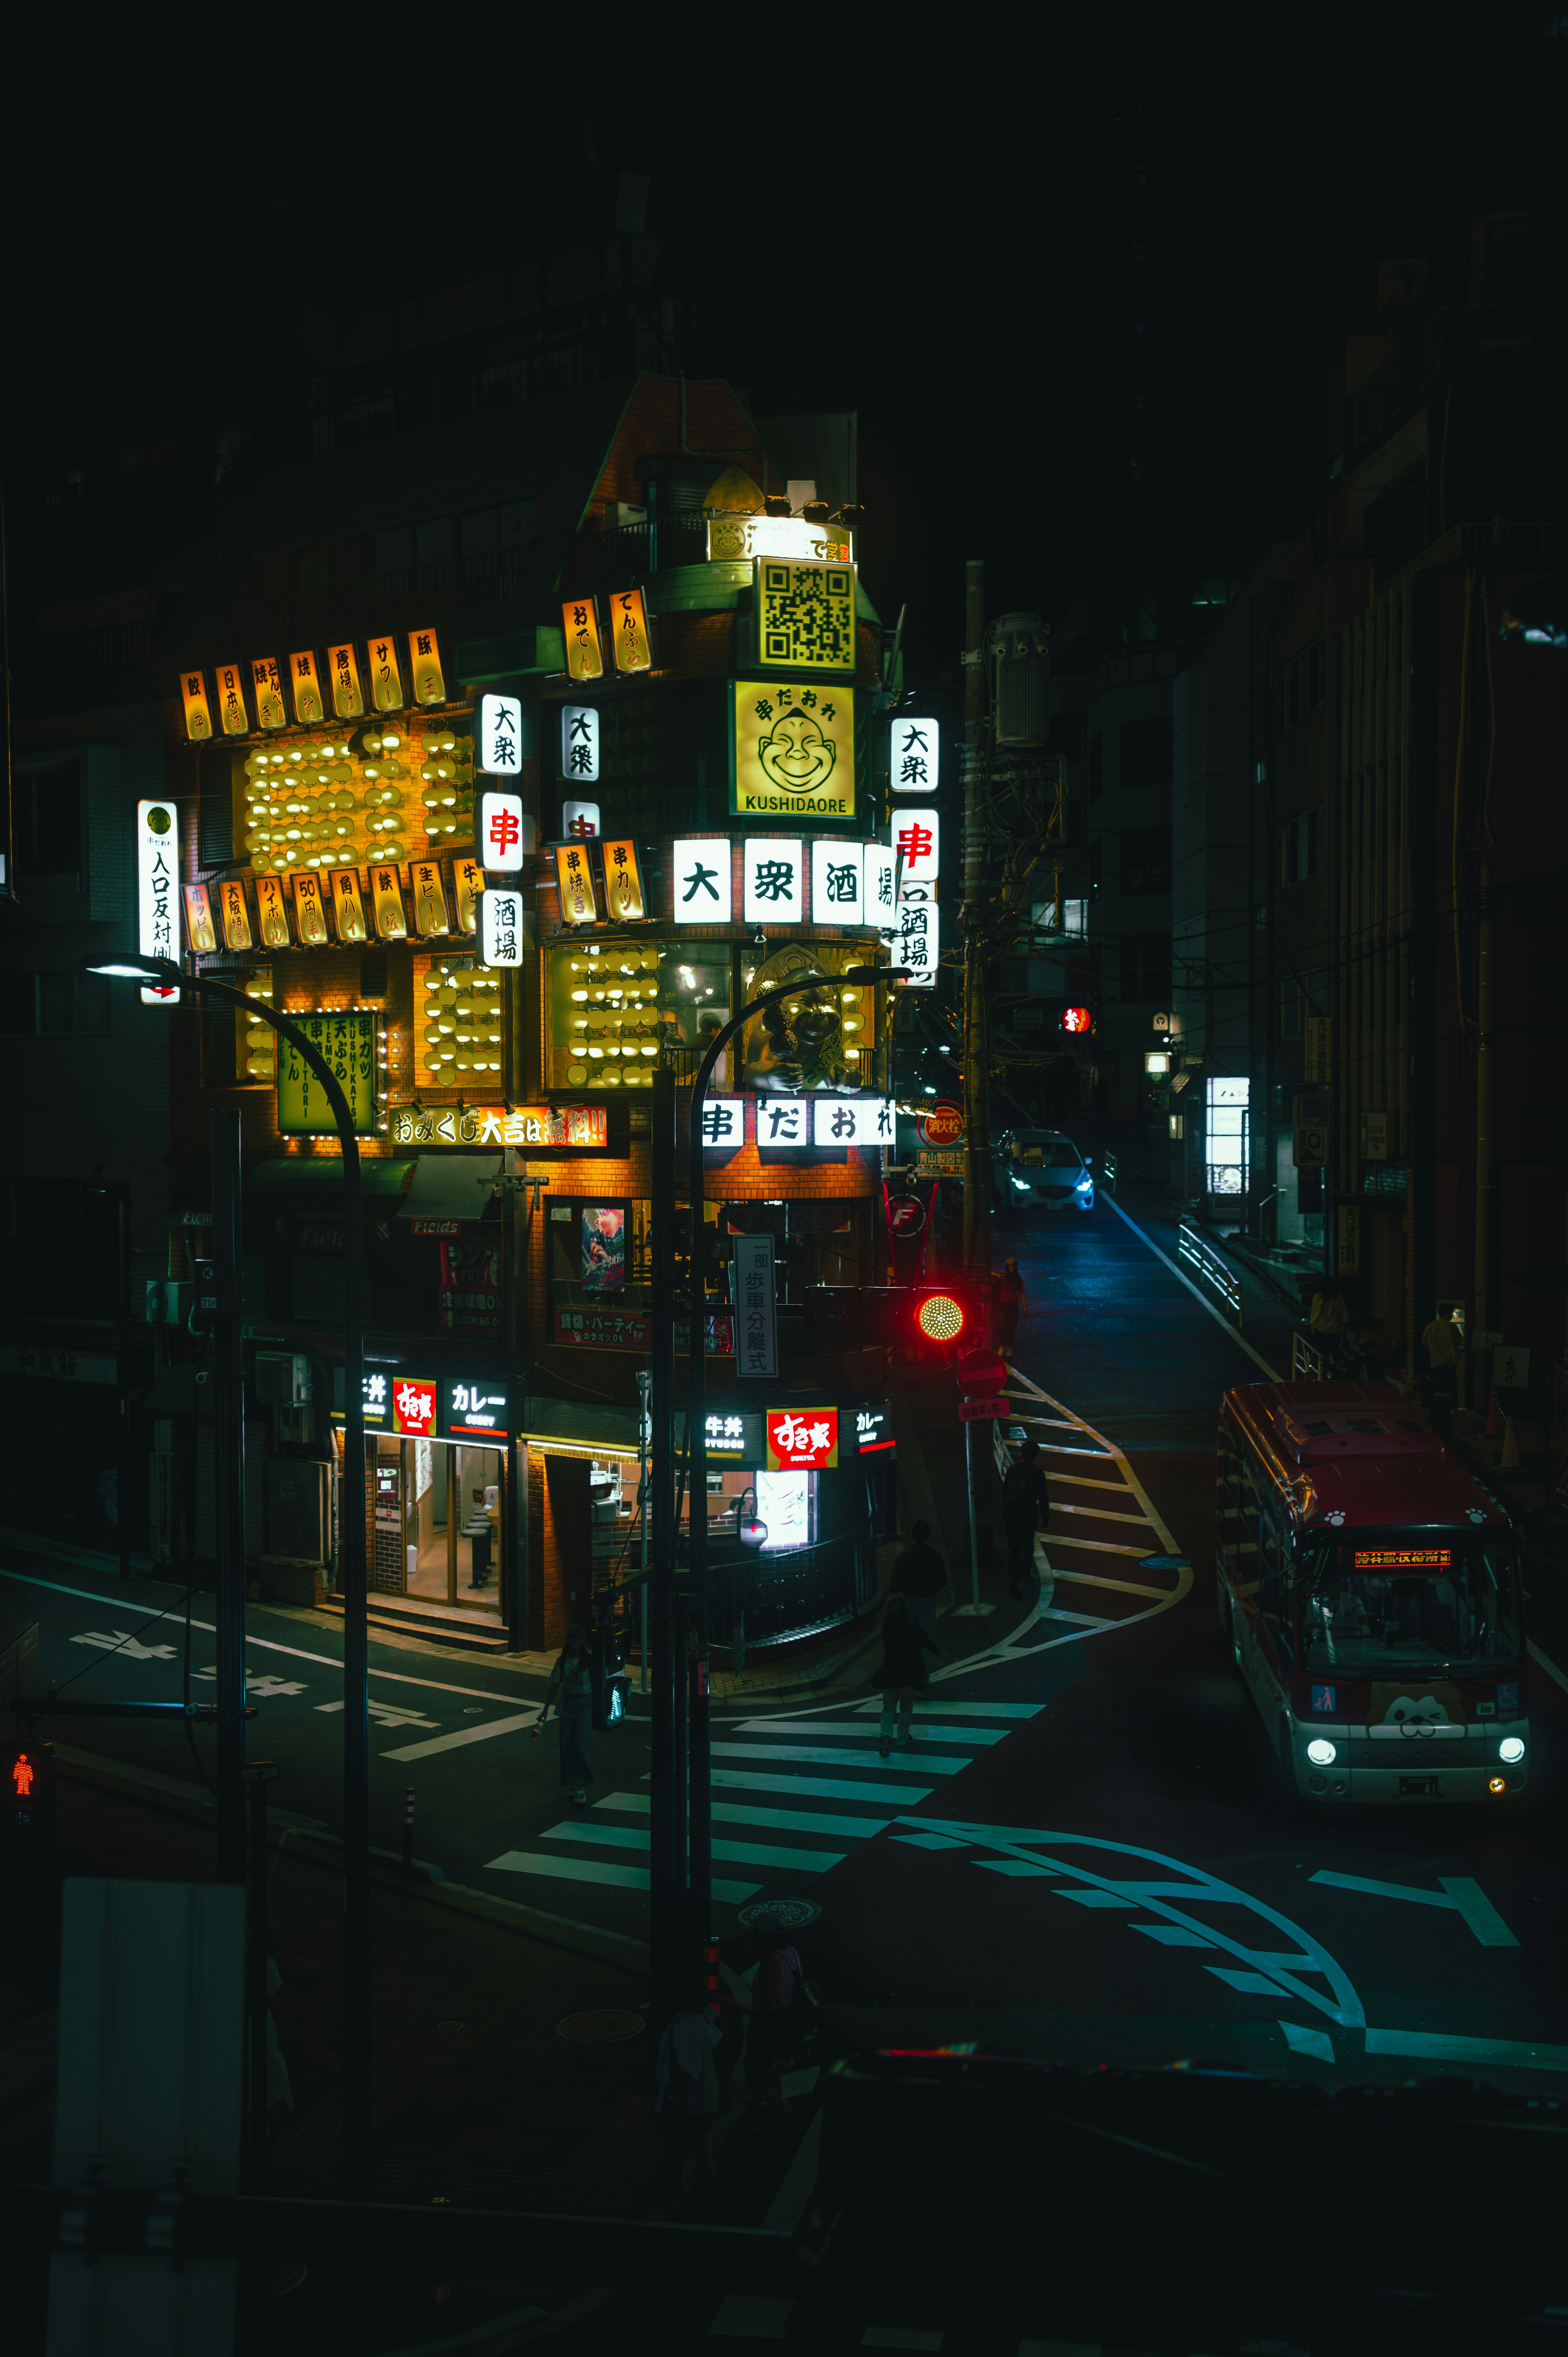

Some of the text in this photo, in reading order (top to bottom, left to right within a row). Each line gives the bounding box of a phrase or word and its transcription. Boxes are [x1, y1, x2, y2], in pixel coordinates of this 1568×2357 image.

[574, 606, 592, 671] おでん
[619, 593, 641, 666] てんぷら
[297, 656, 315, 716] 焼酎
[336, 649, 354, 710] 唐揚げ
[376, 643, 391, 703] サワー
[417, 634, 438, 697] 豚玉
[188, 676, 205, 733] 餃子
[224, 670, 242, 730] 日本酒
[754, 688, 836, 722] 串だおれ
[493, 702, 516, 767] 大衆
[900, 725, 929, 783] 大衆
[490, 807, 519, 856] 串
[745, 795, 847, 813] KUSHIDAORE
[896, 822, 932, 869] 串
[339, 875, 356, 936] 角ハイ
[379, 871, 399, 932] 鉄板
[419, 867, 440, 931] 生ビール
[463, 863, 479, 916] 牛ど
[567, 850, 586, 914] 串焼き
[613, 846, 632, 911] 串カツ
[682, 860, 892, 906] 大衆酒場
[191, 887, 207, 948] ホッピー
[227, 884, 245, 945] 大阪焼き
[264, 880, 282, 942] ハイボール
[299, 879, 320, 939] 50円串
[494, 897, 516, 960] 酒場
[900, 906, 929, 966] 酒場
[334, 1019, 347, 1081] 天ぷら
[359, 1020, 371, 1080] 串カツ
[702, 1104, 893, 1143] 串だおれ
[929, 1119, 960, 1133] 消火栓
[1308, 1133, 1321, 1149] Q
[414, 1220, 458, 1233] Fields
[455, 1314, 490, 1327] SMOKING
[560, 1313, 646, 1334] 貸切・パーティー
[583, 1331, 624, 1345] カラオケOK
[363, 1375, 386, 1403] 丼
[396, 1383, 432, 1421] すき家
[452, 1385, 506, 1412] カレー
[963, 1403, 1006, 1418] 自転車を除く
[705, 1416, 743, 1437] 牛丼
[773, 1414, 831, 1453] すき家
[856, 1412, 884, 1432] カレー
